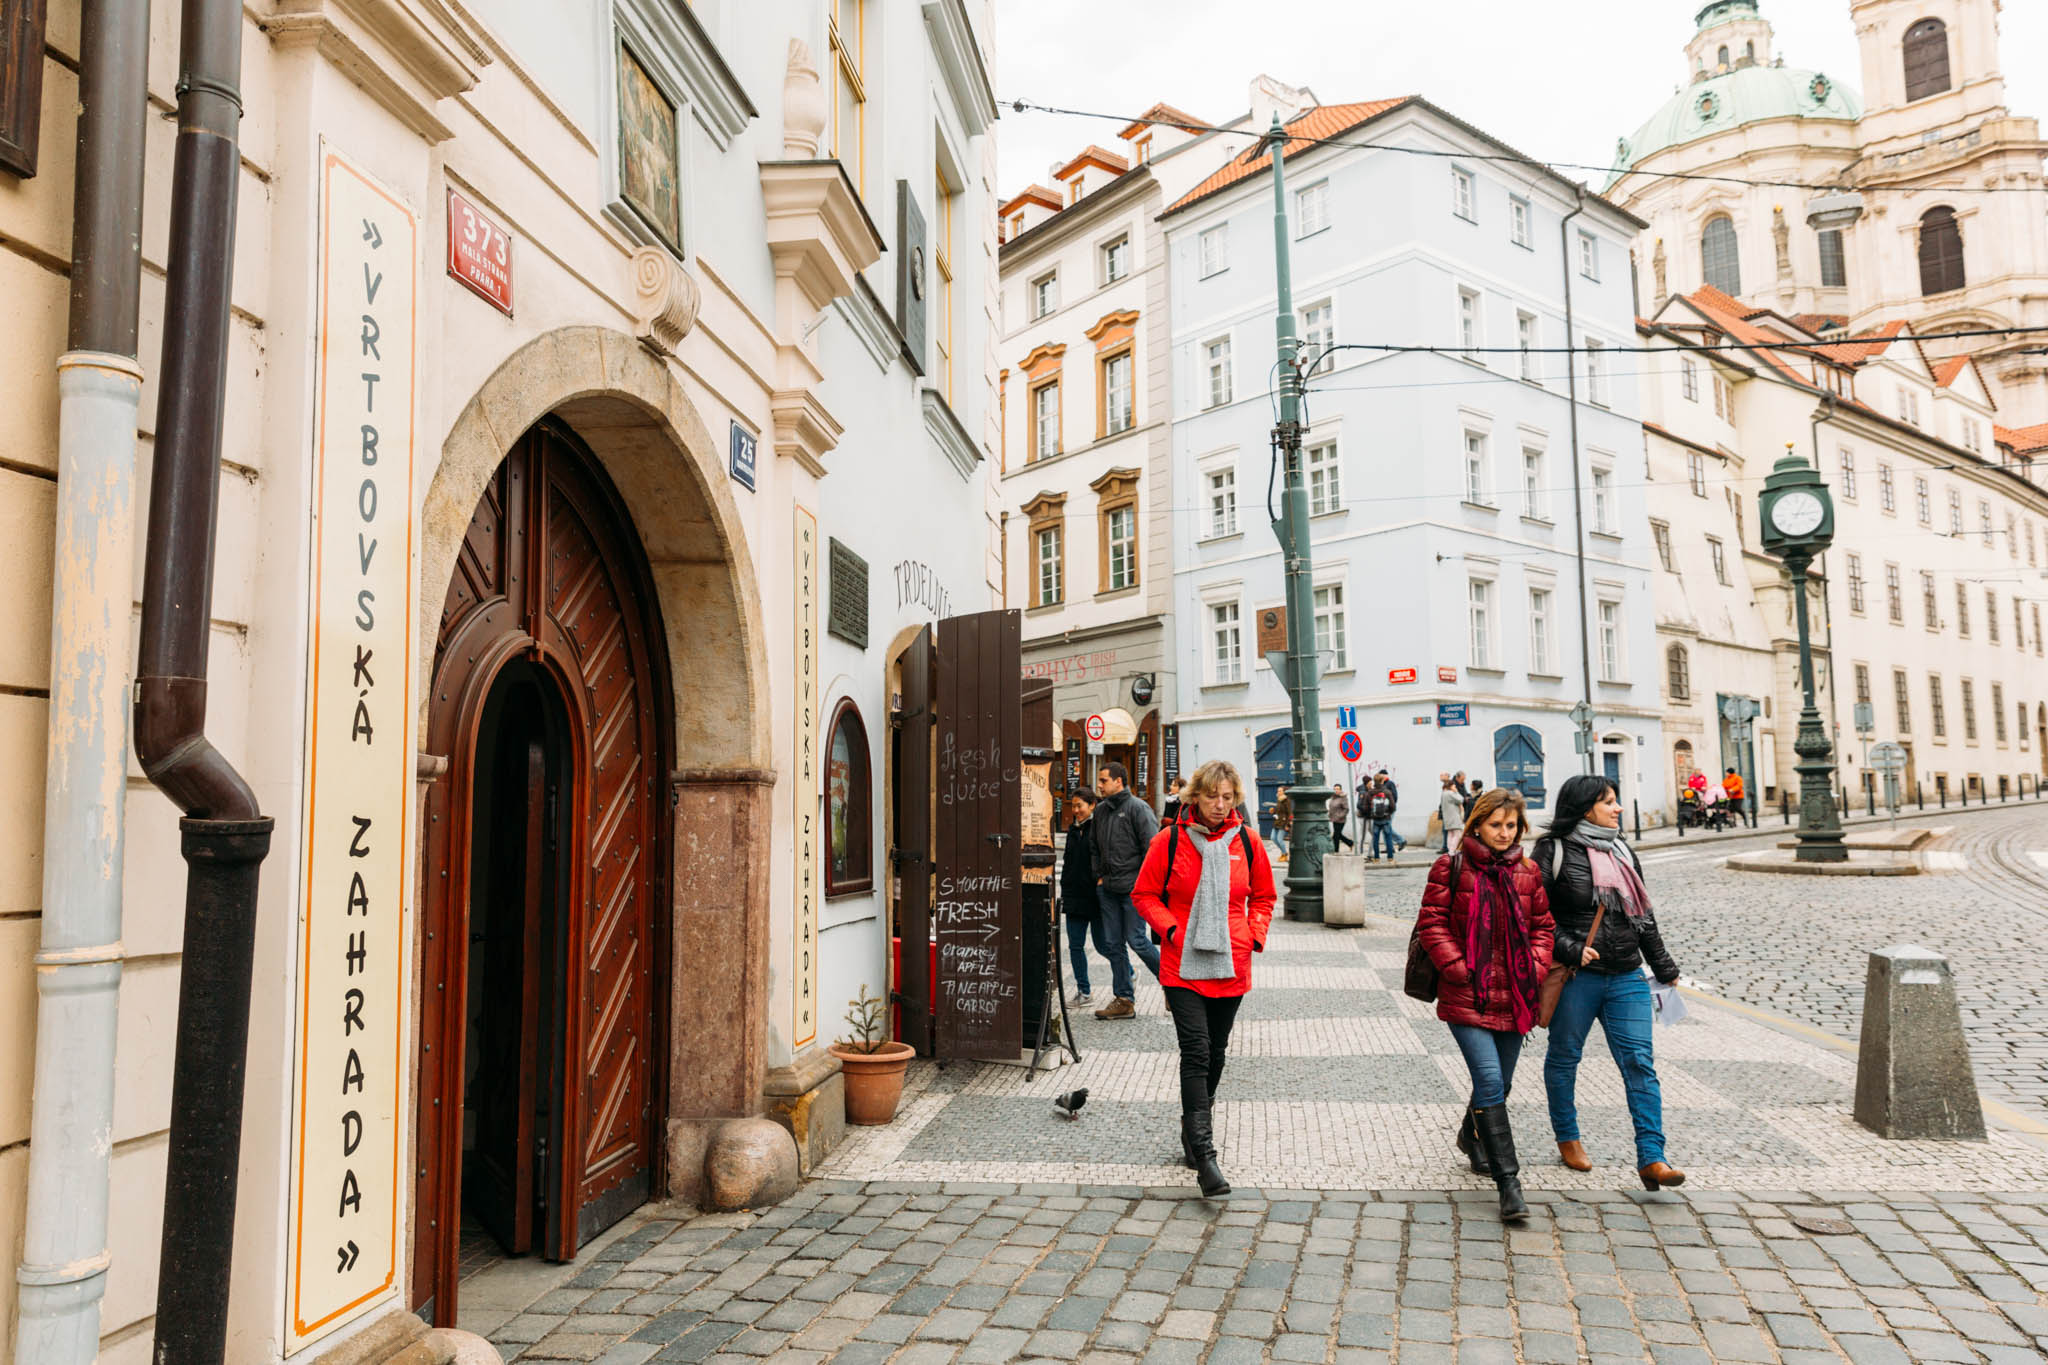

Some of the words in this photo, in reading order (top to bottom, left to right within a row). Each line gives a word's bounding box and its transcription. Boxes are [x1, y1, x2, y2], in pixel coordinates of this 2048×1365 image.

[463, 207, 506, 266] 373
[470, 266, 494, 290] PRAHA
[482, 257, 508, 285] STRANA
[740, 435, 754, 464] 25
[1090, 651, 1116, 666] IRISH
[941, 732, 1001, 771] fresh
[943, 774, 1001, 805] juice
[937, 901, 999, 923] FRESH
[957, 961, 997, 976] APPLE
[956, 998, 1002, 1014] CARROT
